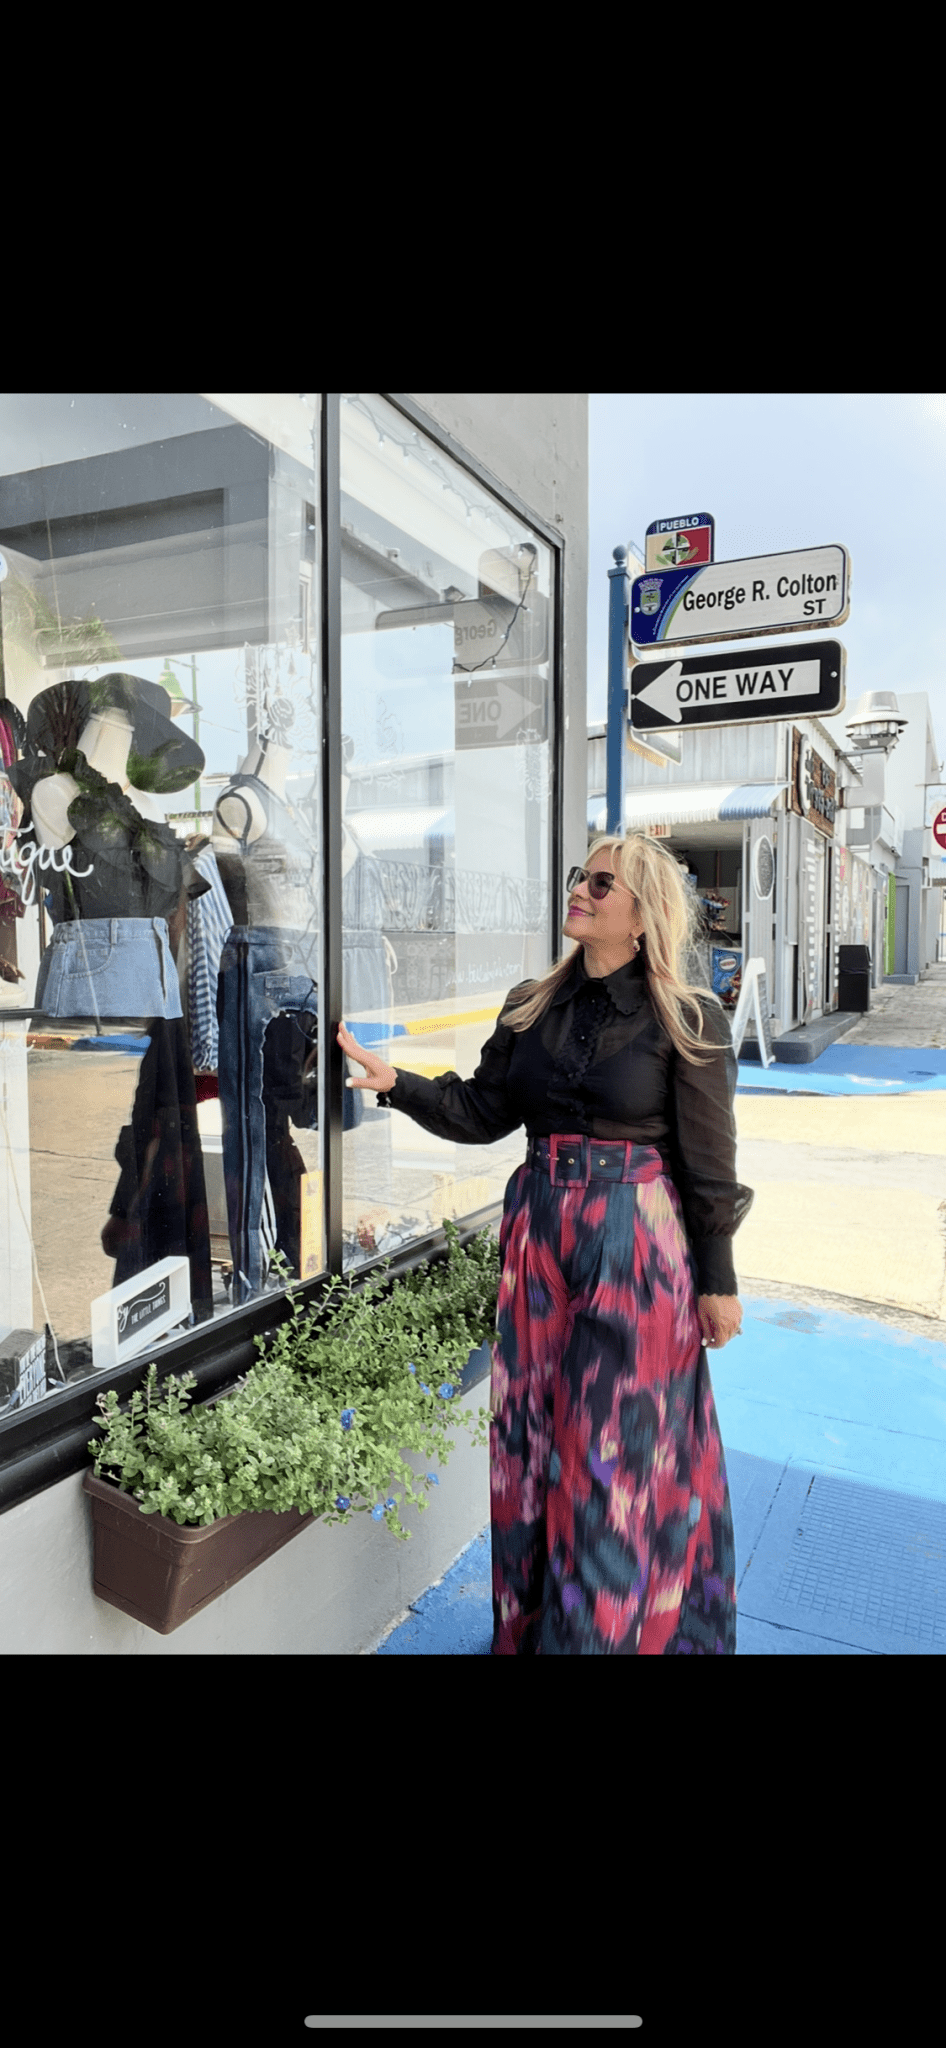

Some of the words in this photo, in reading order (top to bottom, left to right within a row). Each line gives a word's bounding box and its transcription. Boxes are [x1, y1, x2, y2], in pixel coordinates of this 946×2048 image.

[660, 516, 700, 531] PUEBLO
[683, 586, 746, 611] George
[752, 580, 770, 601] R.
[777, 574, 837, 598] Colton
[803, 598, 827, 616] ST
[676, 675, 727, 703] ONE
[735, 668, 795, 696] WAY
